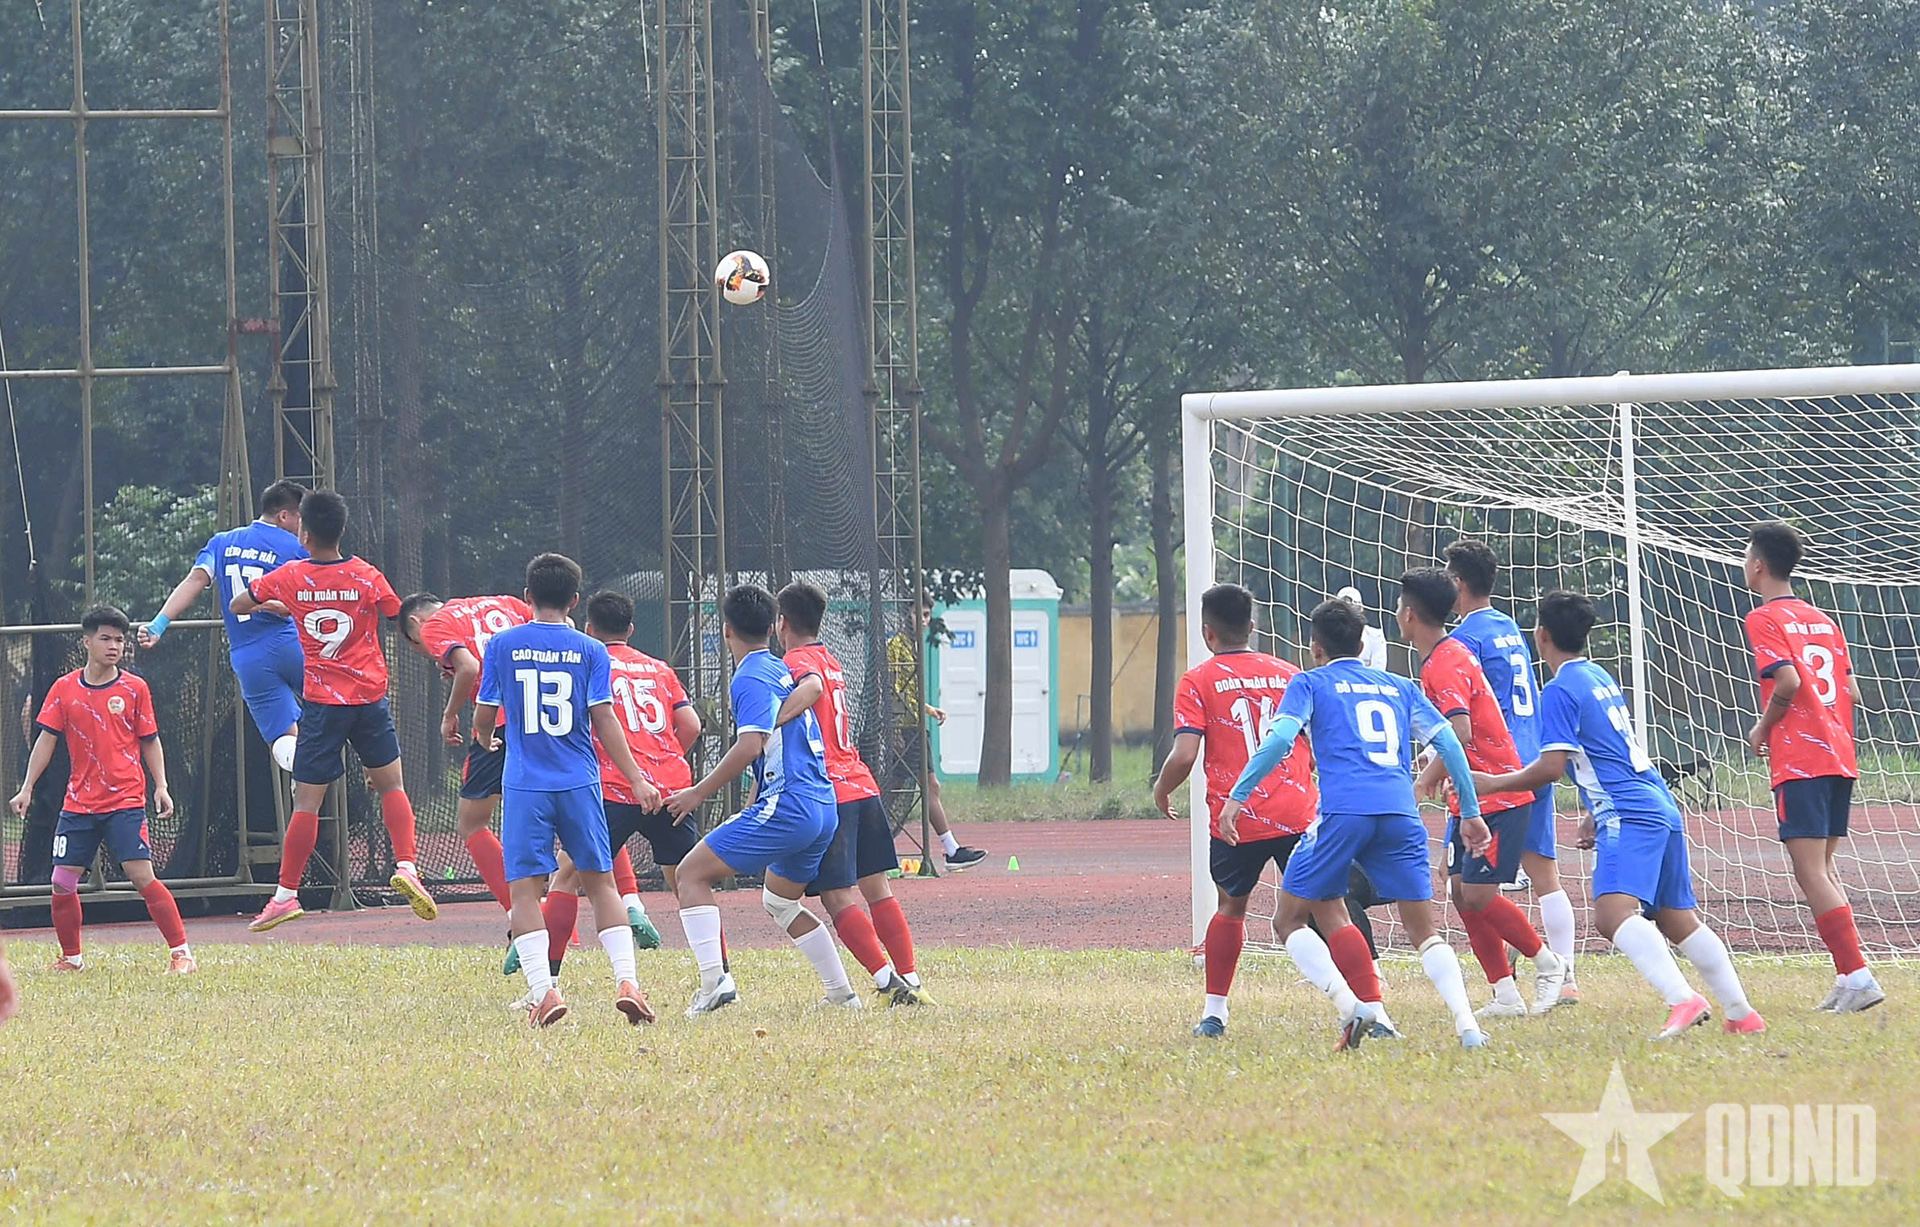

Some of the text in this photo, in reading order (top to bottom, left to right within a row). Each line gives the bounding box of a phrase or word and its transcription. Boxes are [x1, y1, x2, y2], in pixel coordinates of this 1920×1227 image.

[303, 608, 353, 660] 9
[511, 648, 532, 661] CAO
[532, 649, 560, 664] XUÂN
[514, 668, 573, 737] 13
[612, 676, 668, 735] 15
[1510, 653, 1534, 717] 3
[1801, 643, 1838, 707] 3
[1355, 699, 1400, 767] 9
